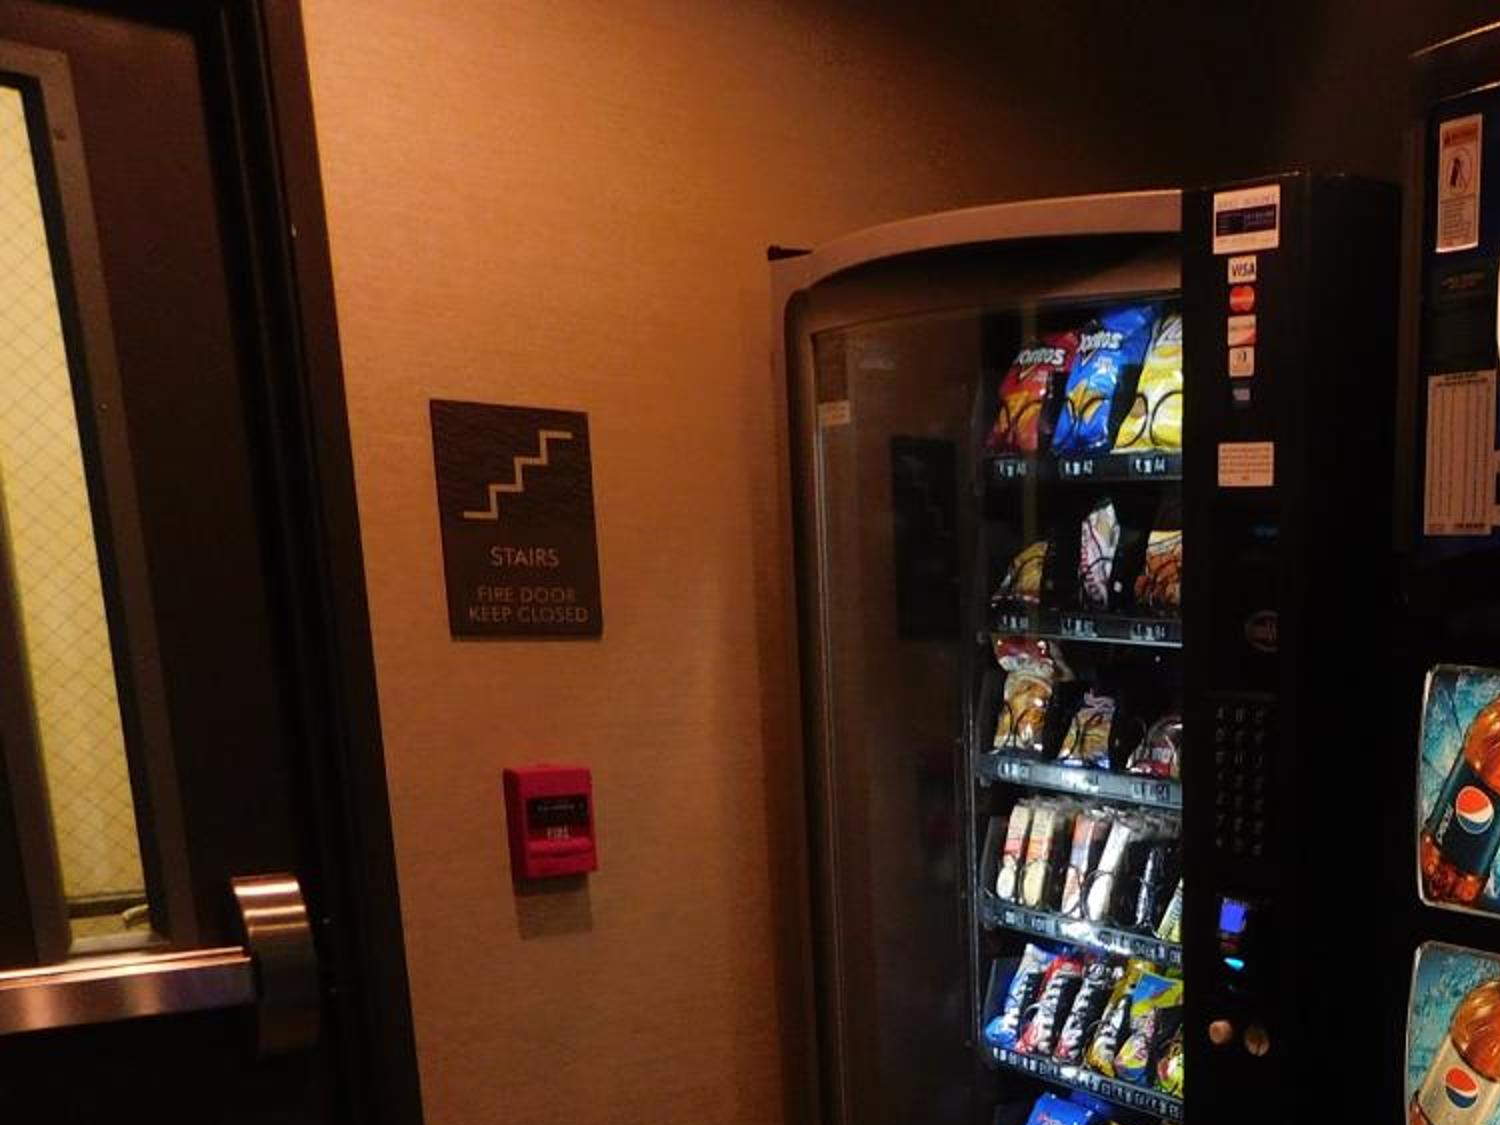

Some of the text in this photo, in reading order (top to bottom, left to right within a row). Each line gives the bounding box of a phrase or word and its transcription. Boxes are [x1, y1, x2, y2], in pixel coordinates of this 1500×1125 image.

[489, 547, 560, 569] STAIRS
[477, 585, 577, 604] FIRE DOOR
[468, 605, 590, 625] KEEP CLOSED
